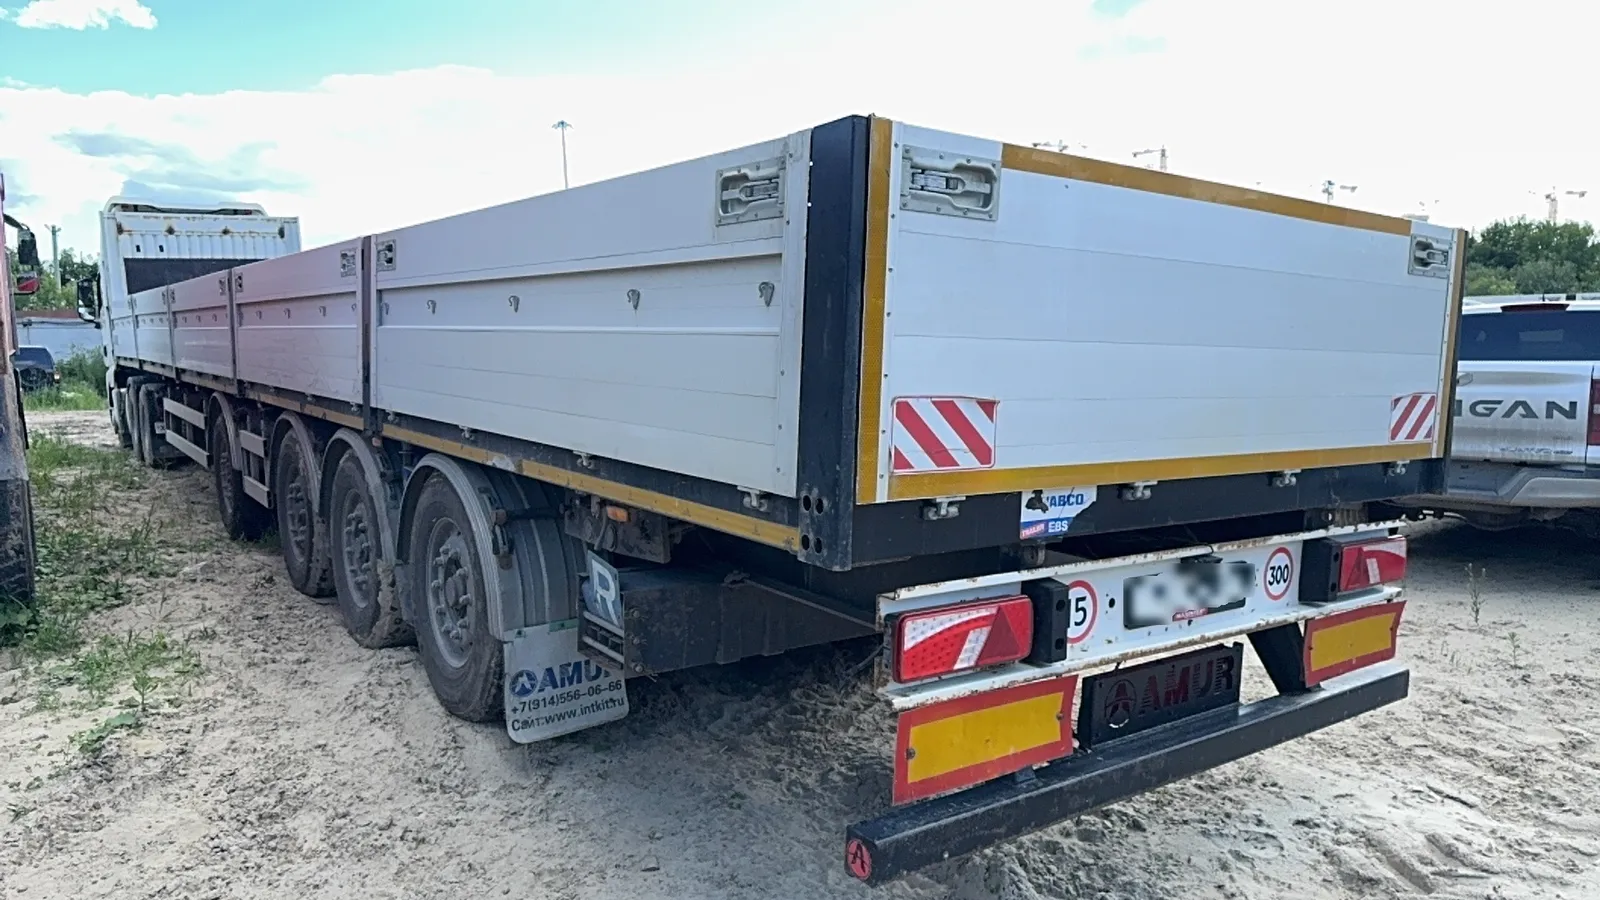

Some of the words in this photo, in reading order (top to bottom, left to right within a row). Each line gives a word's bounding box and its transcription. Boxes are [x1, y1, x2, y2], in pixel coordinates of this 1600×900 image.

[1046, 493, 1084, 508] ABCO
[1048, 520, 1069, 533] EBS
[1268, 564, 1290, 586] 300
[591, 558, 620, 627] R
[1139, 655, 1235, 717] AMUR
